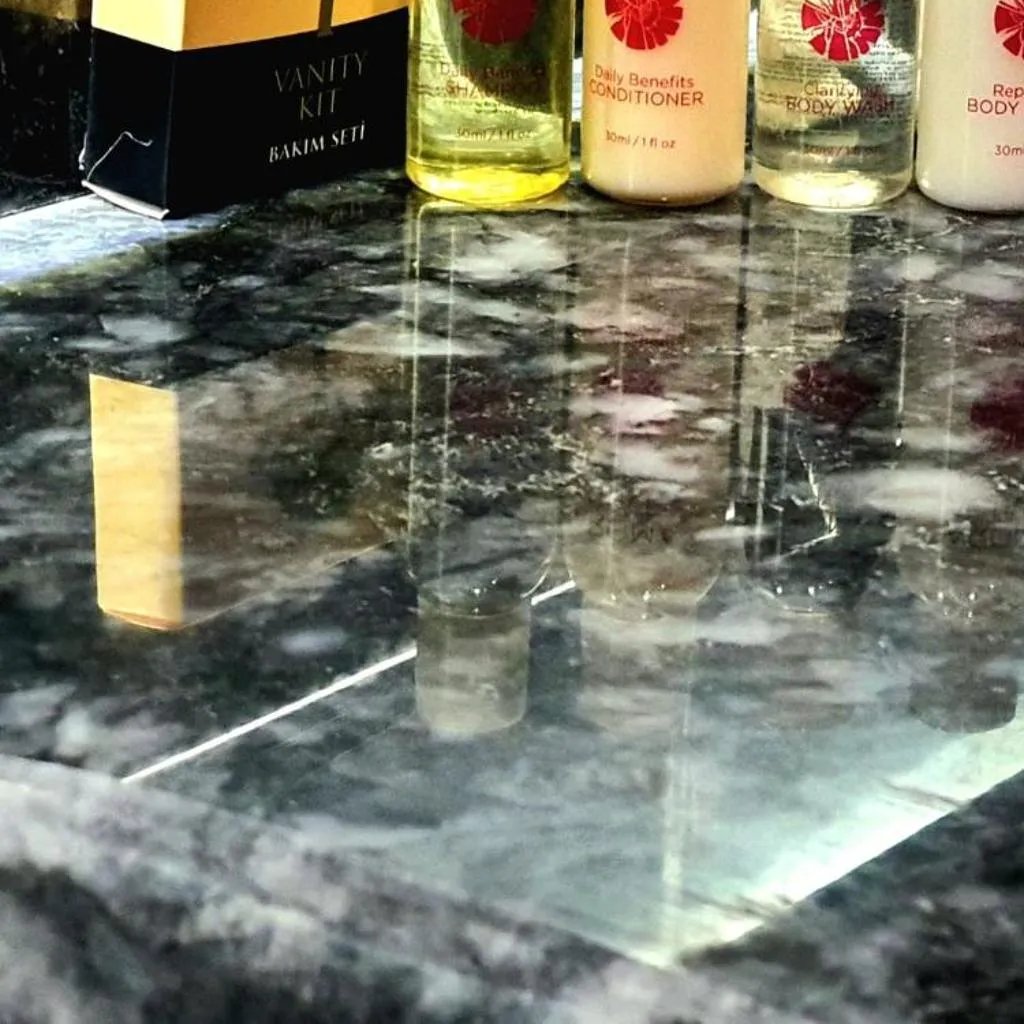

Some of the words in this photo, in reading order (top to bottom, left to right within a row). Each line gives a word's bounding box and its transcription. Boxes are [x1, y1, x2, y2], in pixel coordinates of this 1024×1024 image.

[274, 50, 368, 92] VANITY
[594, 64, 624, 86] Daily
[629, 73, 694, 89] Benefits
[589, 79, 704, 106] CONDITIONER
[803, 80, 888, 100] Clarify
[300, 88, 342, 120] KIT
[785, 96, 836, 115] BODY
[968, 98, 1019, 115] BODY
[269, 135, 325, 163] BAKIM
[994, 143, 1024, 156] 30ml
